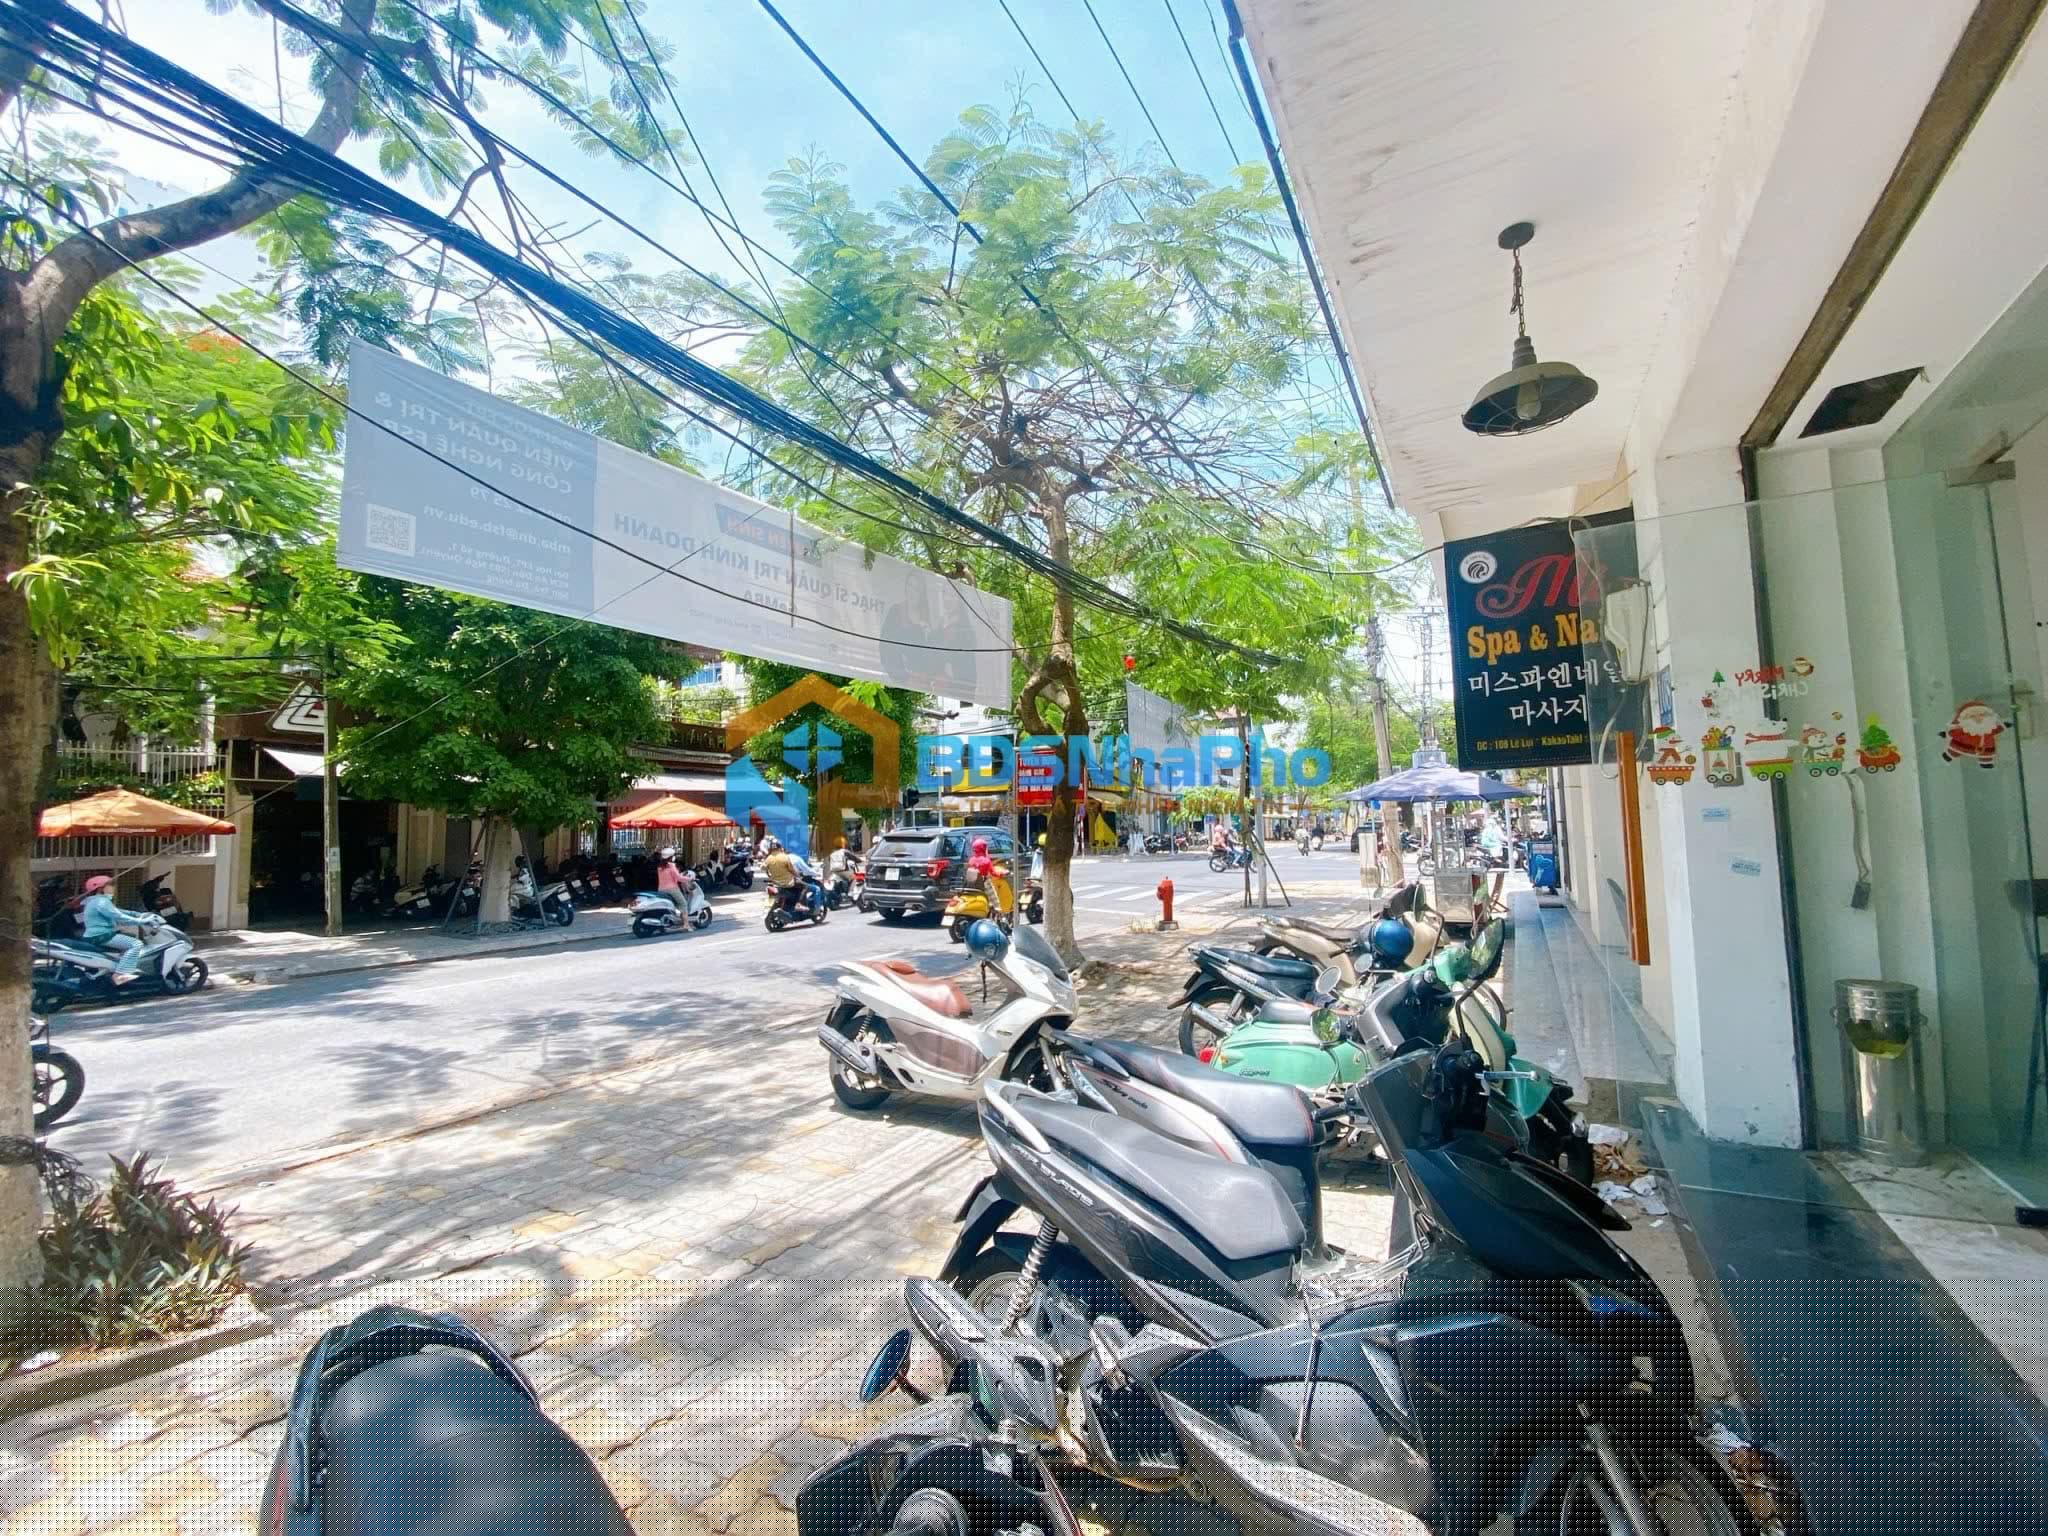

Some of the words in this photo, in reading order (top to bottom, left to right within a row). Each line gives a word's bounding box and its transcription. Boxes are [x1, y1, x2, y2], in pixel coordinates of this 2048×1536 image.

[1467, 625, 1521, 666] Spa
[1530, 624, 1548, 650] &
[1509, 694, 1588, 727] 마사지
